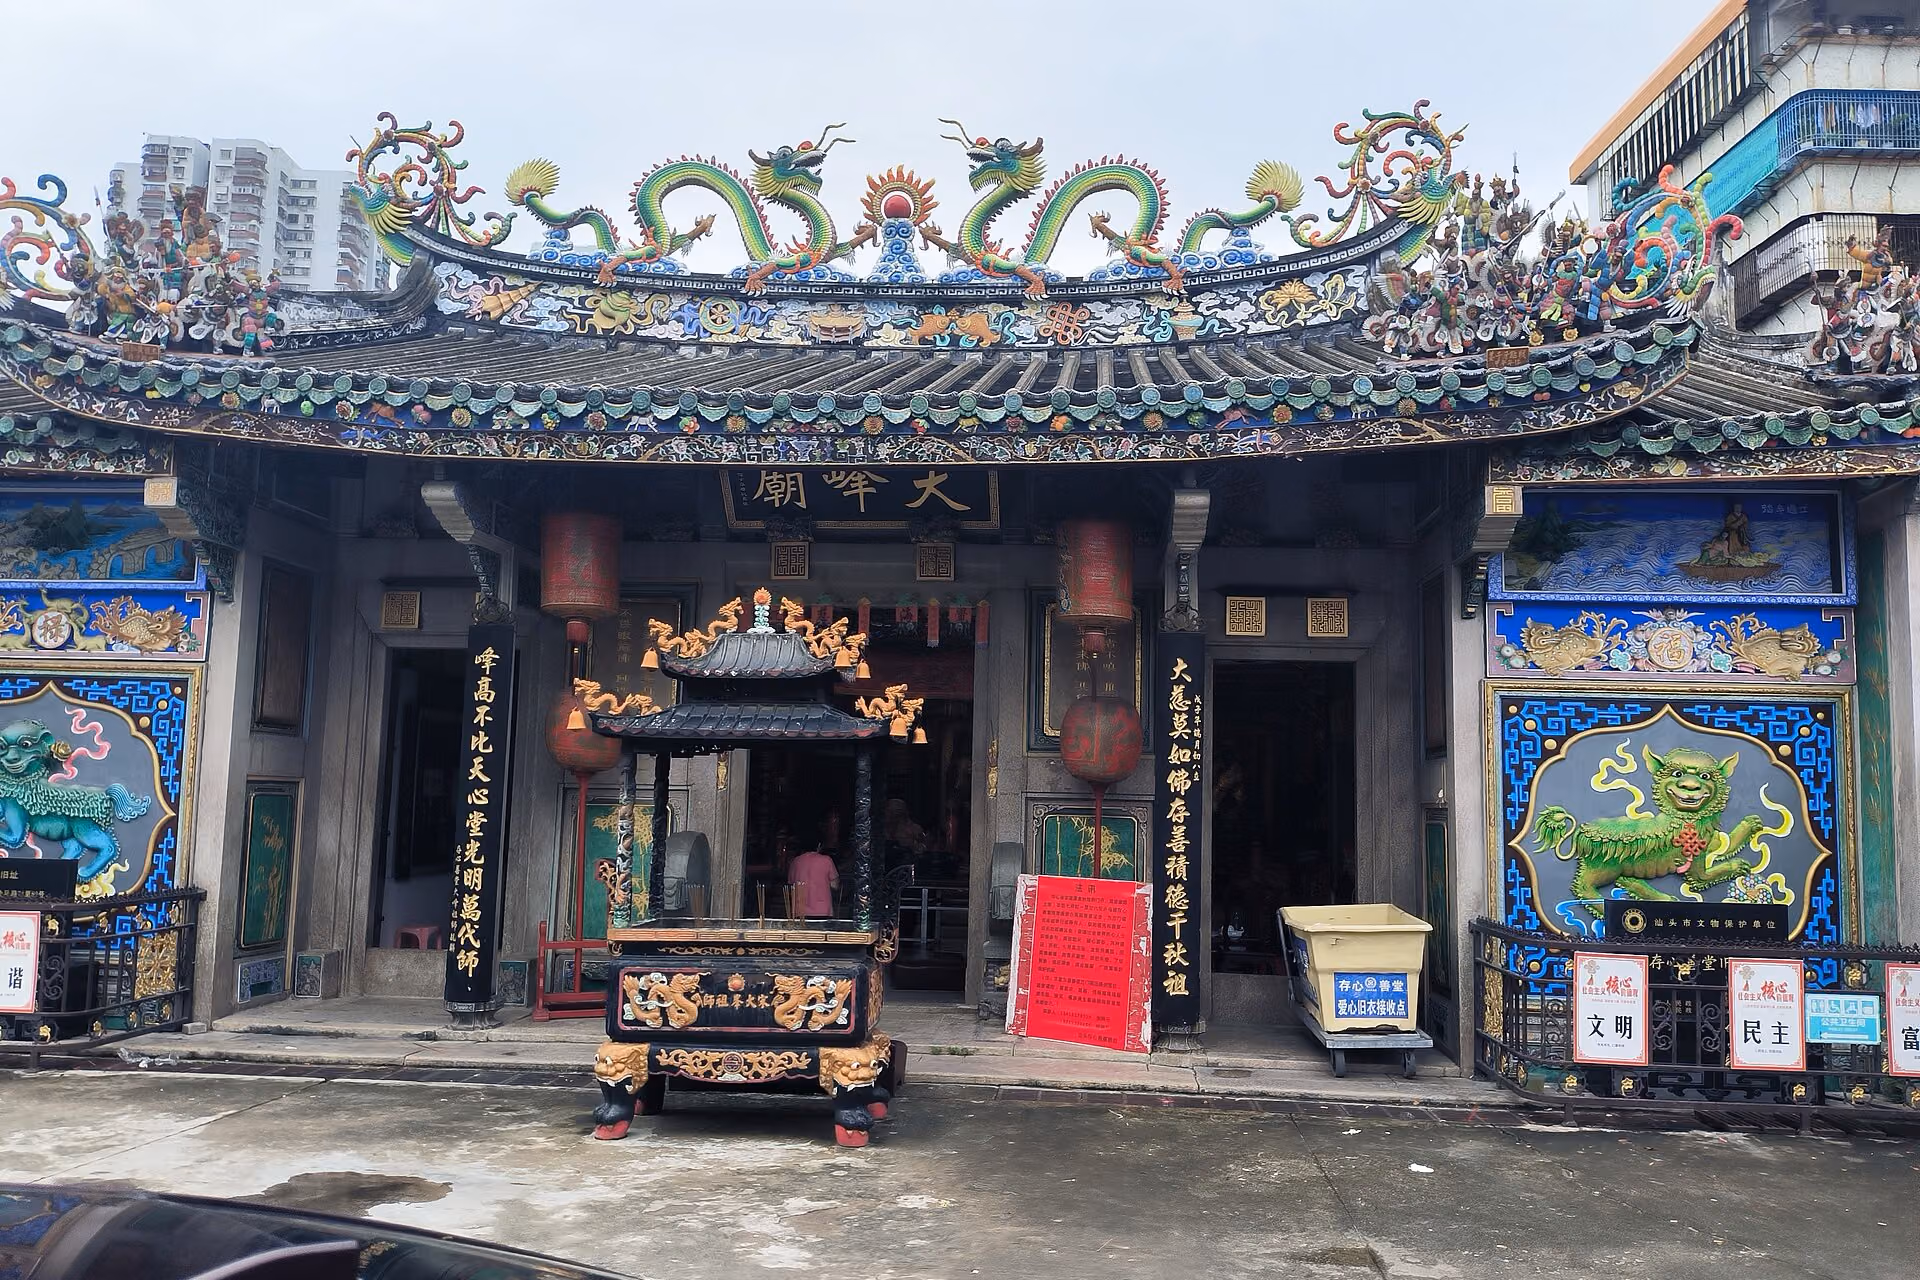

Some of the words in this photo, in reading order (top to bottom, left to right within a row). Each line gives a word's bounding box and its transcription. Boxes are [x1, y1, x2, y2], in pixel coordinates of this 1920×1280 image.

[752, 470, 971, 513] 大峰廟
[1, 870, 19, 880] 旧址
[1654, 918, 1776, 929] 汕头市文物保护单位
[8, 967, 24, 989] 谐
[1337, 999, 1406, 1016] 爱心旧衣接收点
[1586, 1013, 1633, 1041] 文明
[1743, 1019, 1790, 1045] 民主
[1901, 1025, 1920, 1051] 富
